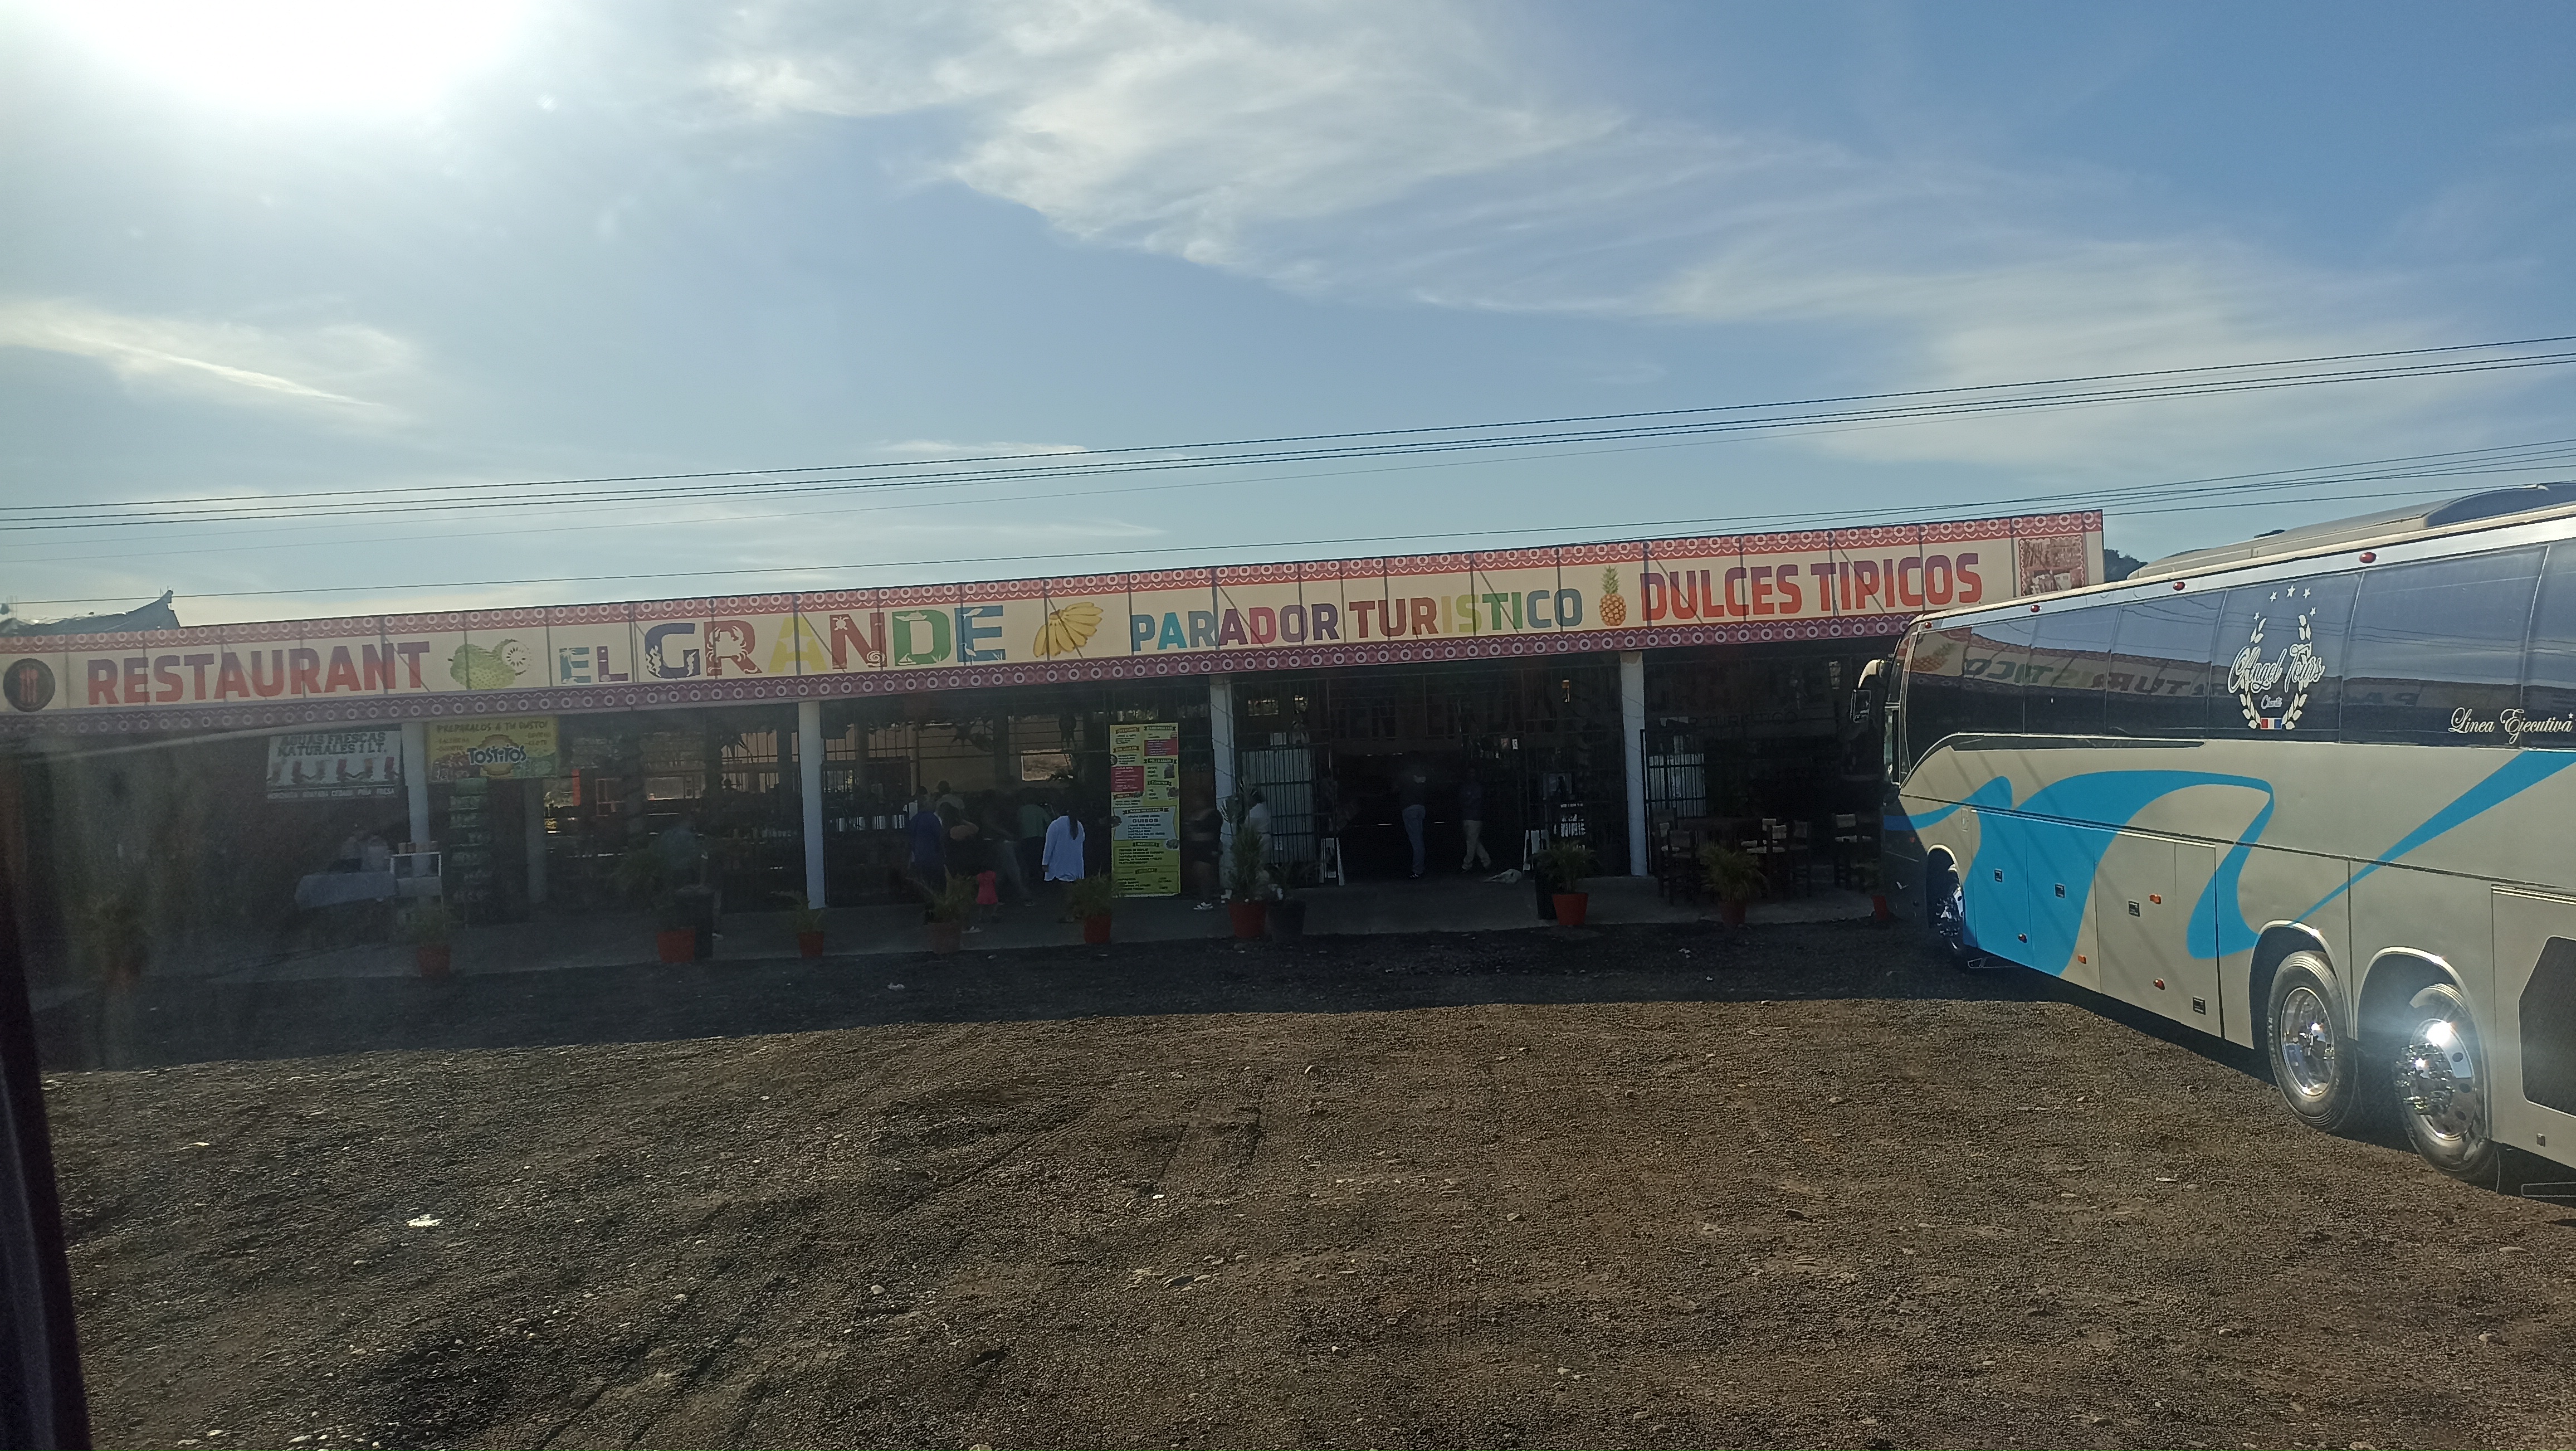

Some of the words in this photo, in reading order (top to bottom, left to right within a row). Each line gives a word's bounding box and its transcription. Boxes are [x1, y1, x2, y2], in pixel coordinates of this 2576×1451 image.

[1640, 564, 1802, 621] DULCES
[1811, 553, 1982, 611] TIPICOS
[559, 646, 628, 685] EL
[644, 605, 1006, 679] GRANDE
[1131, 602, 1340, 652] PARADOR
[1349, 588, 1583, 638] TURISTICO
[87, 641, 430, 705] RESTAURANT
[2284, 643, 2325, 693] Tours
[278, 744, 355, 756] NATURALES
[328, 732, 386, 744] FRESCAS
[2500, 708, 2573, 744] Ejecutiva
